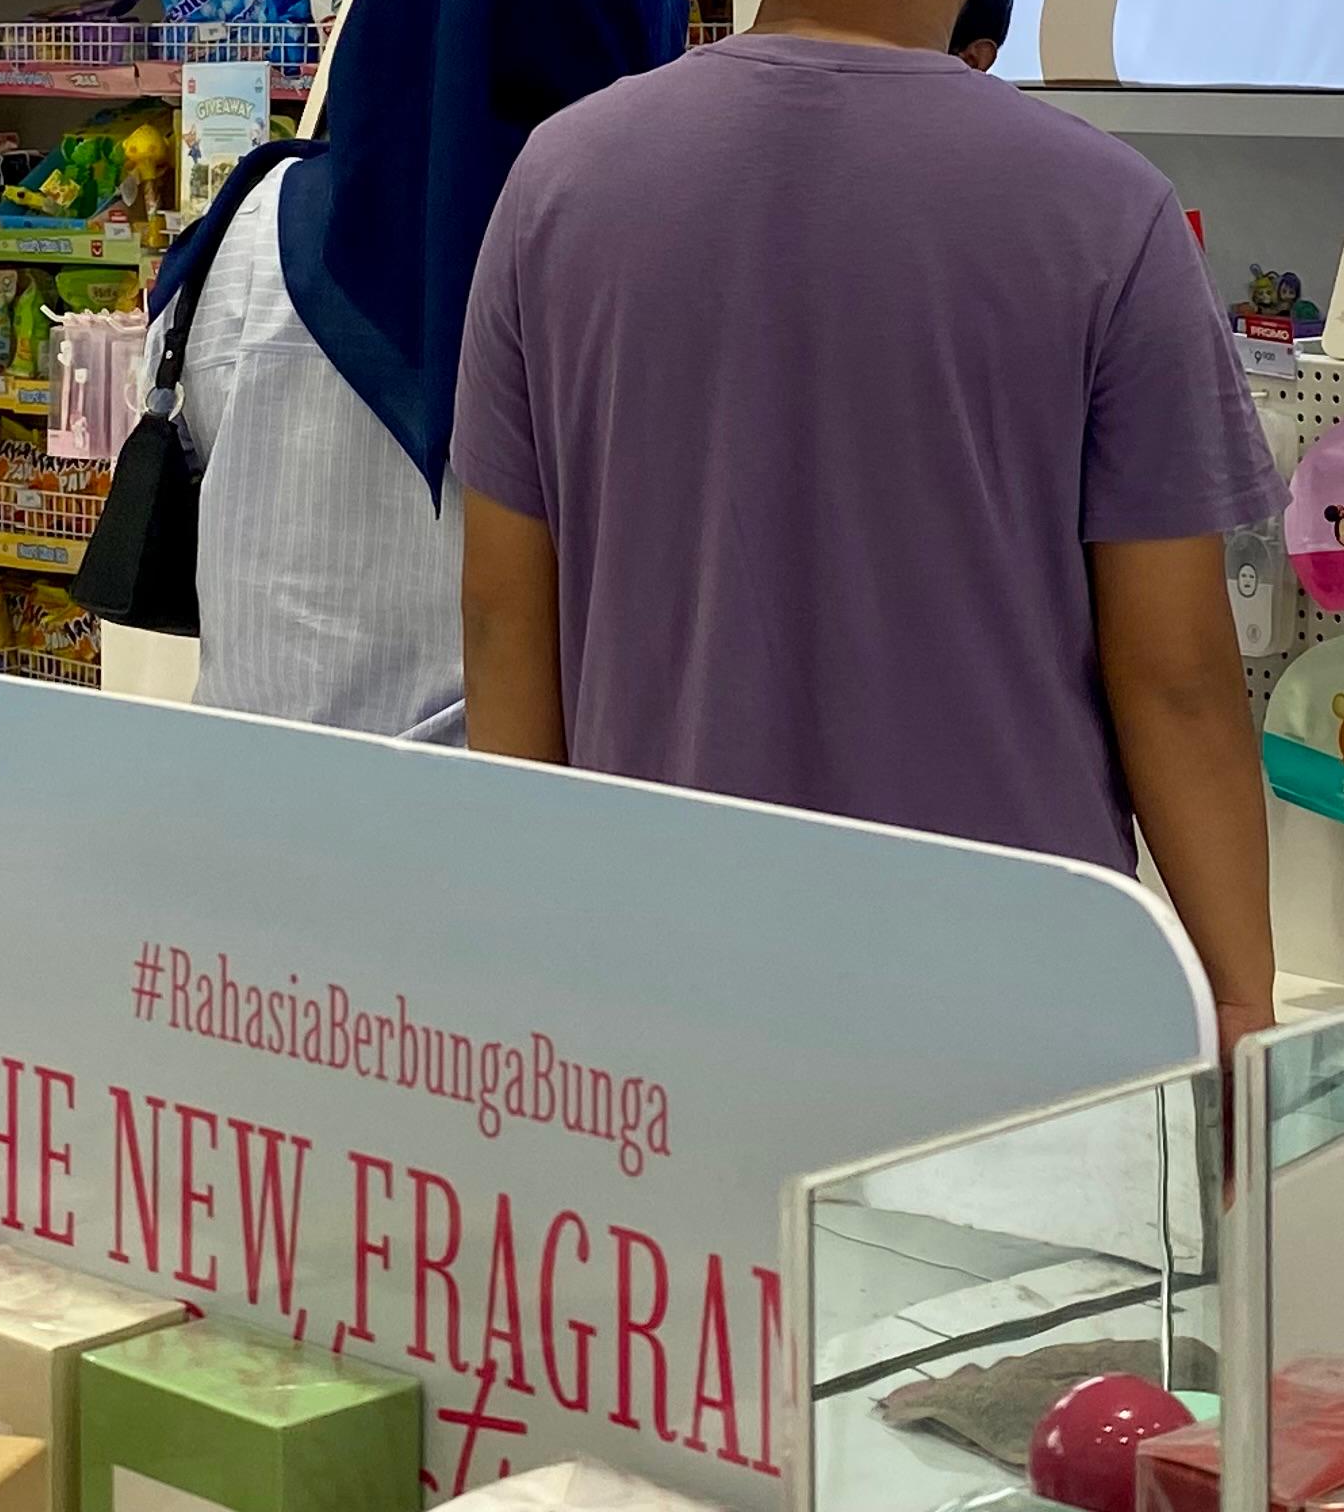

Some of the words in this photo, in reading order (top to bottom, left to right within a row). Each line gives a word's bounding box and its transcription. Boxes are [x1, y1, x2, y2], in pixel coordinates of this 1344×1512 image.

[196, 96, 255, 121] GIVEAWAY
[1250, 326, 1290, 340] PROMO
[132, 940, 671, 1178] #RahasiaBerbungaBunga
[107, 1084, 313, 1319] NEW
